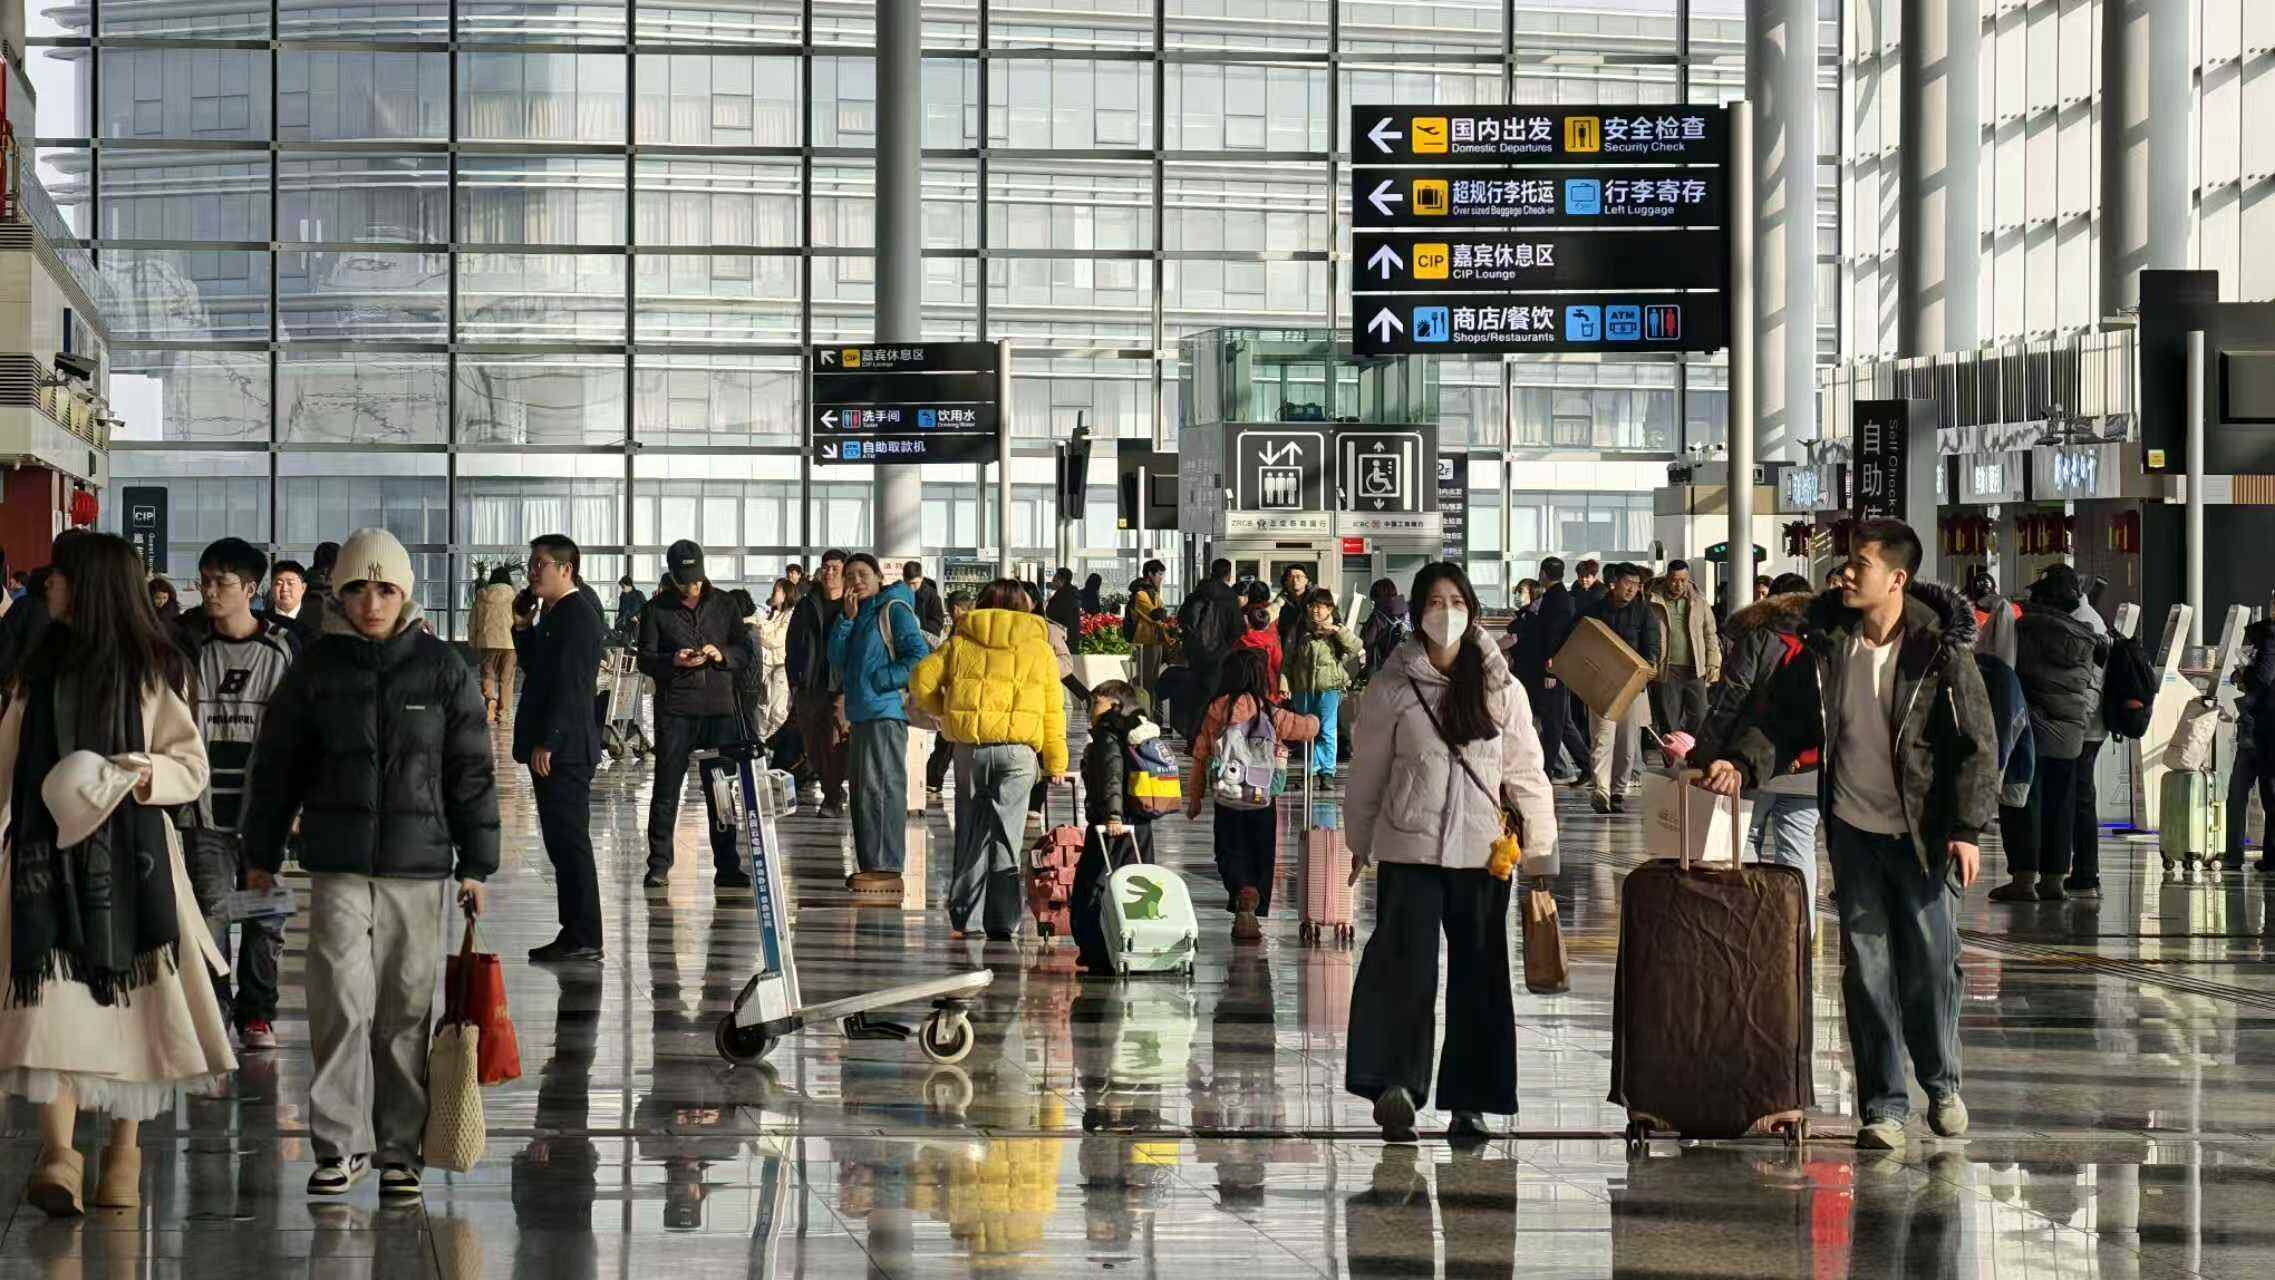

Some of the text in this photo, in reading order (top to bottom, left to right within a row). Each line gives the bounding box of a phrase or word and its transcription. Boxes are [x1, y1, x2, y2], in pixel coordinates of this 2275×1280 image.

[1451, 117, 1553, 141] 国内出发
[1604, 116, 1706, 140] 安全检查
[1452, 143, 1553, 153] Domestic Departures
[1604, 142, 1685, 153] Security Check
[1452, 180, 1555, 204] 超规行李托运
[1604, 179, 1706, 204] 行李寄存
[1491, 205, 1521, 217] Baggage
[1523, 205, 1555, 215] Check-in
[1604, 205, 1675, 216] Left Luggage
[1418, 255, 1444, 268] CIP
[1453, 244, 1555, 268] 嘉宾休息区
[1453, 269, 1516, 280] CIP Lounge
[1453, 307, 1554, 331] 商店/餐饮
[1611, 312, 1635, 320] ATM
[1453, 332, 1554, 343] Shops/Restaurants
[862, 409, 900, 422] 洗手间
[937, 409, 975, 422] 饮用水
[862, 440, 926, 454] 自助取款机
[135, 512, 154, 521] CIP
